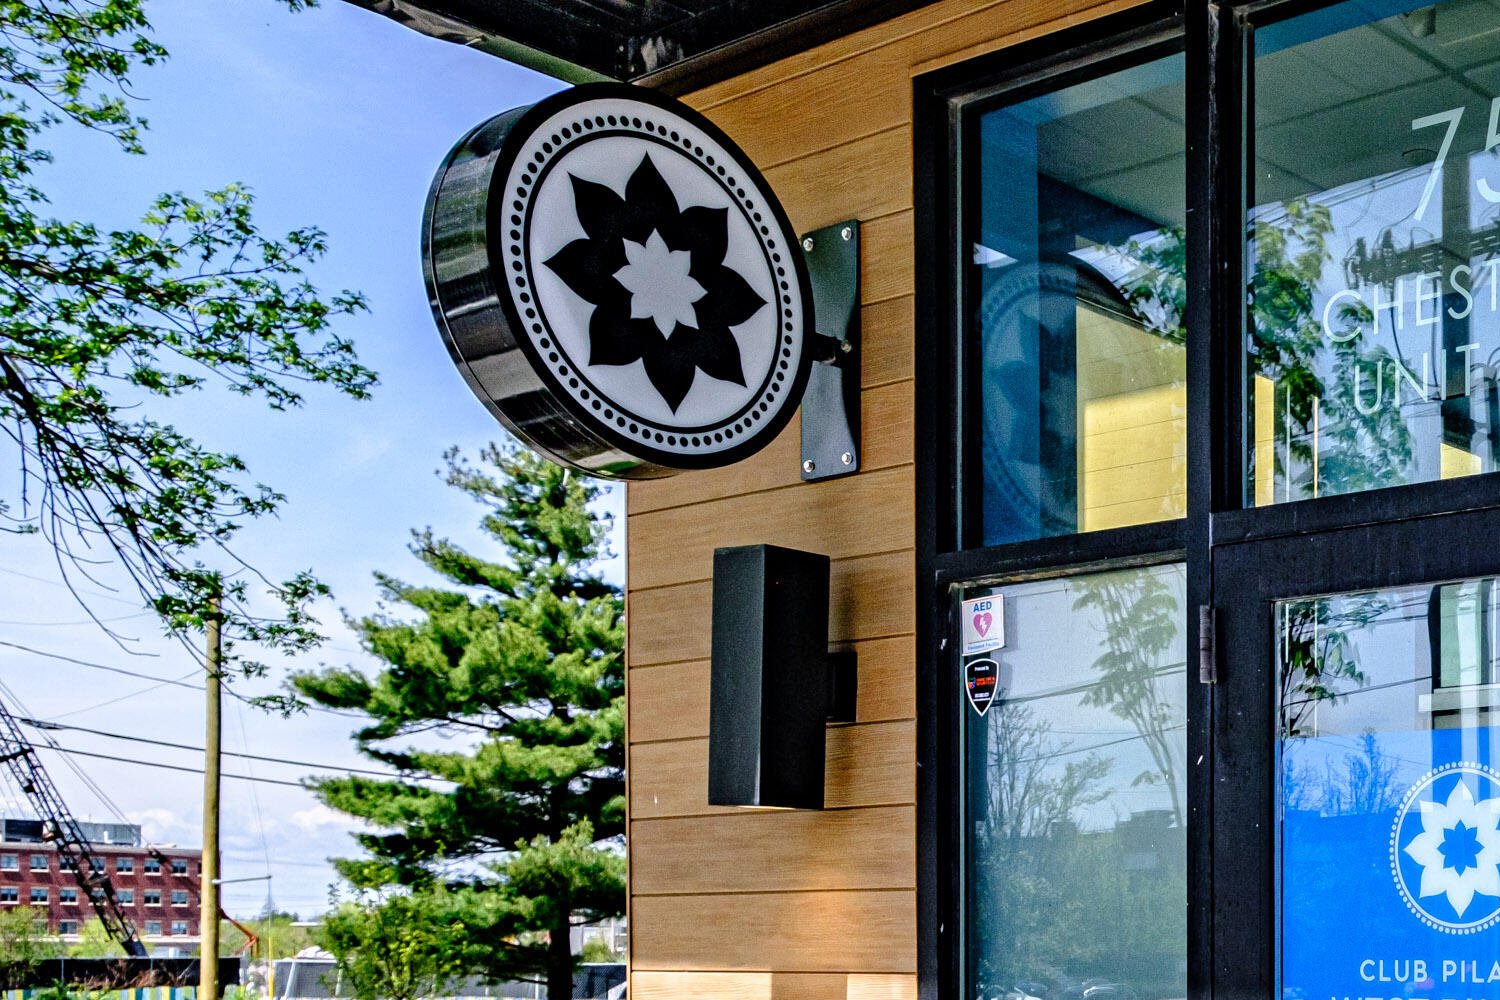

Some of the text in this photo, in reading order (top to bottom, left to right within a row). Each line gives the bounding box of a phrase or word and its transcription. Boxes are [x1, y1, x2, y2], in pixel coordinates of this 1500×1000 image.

[1354, 342, 1481, 415] UNIT
[973, 600, 992, 612] AED
[1359, 959, 1428, 983] CLUB
